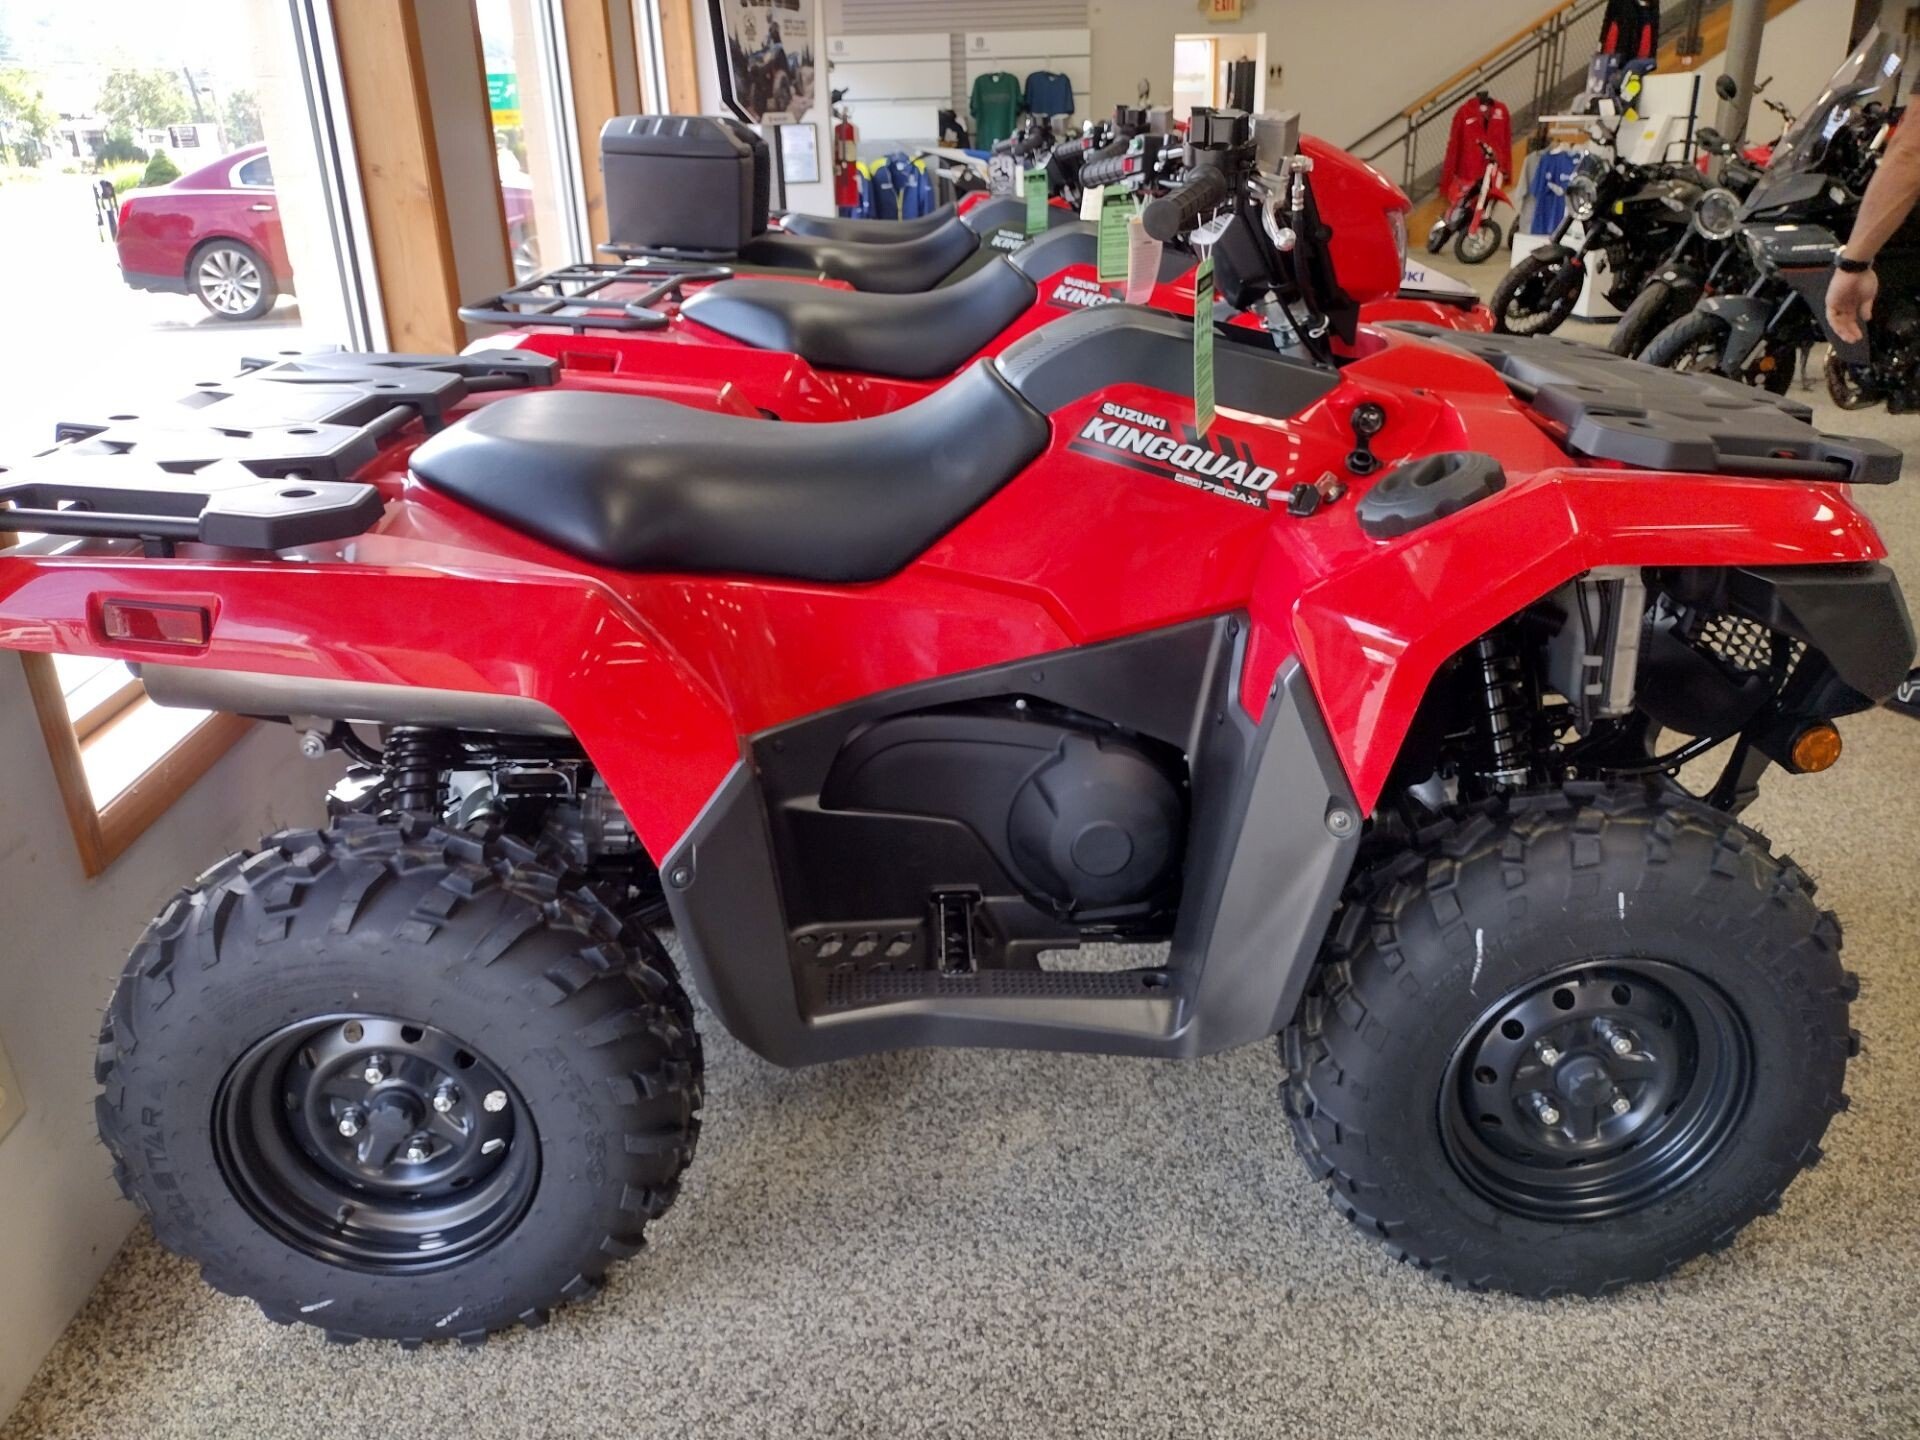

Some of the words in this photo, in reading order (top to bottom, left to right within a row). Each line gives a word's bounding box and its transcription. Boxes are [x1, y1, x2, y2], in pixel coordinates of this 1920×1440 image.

[1063, 276, 1101, 292] SUZUKI
[1102, 402, 1167, 430] SUZUKI
[1081, 417, 1279, 491] KINGQUAD
